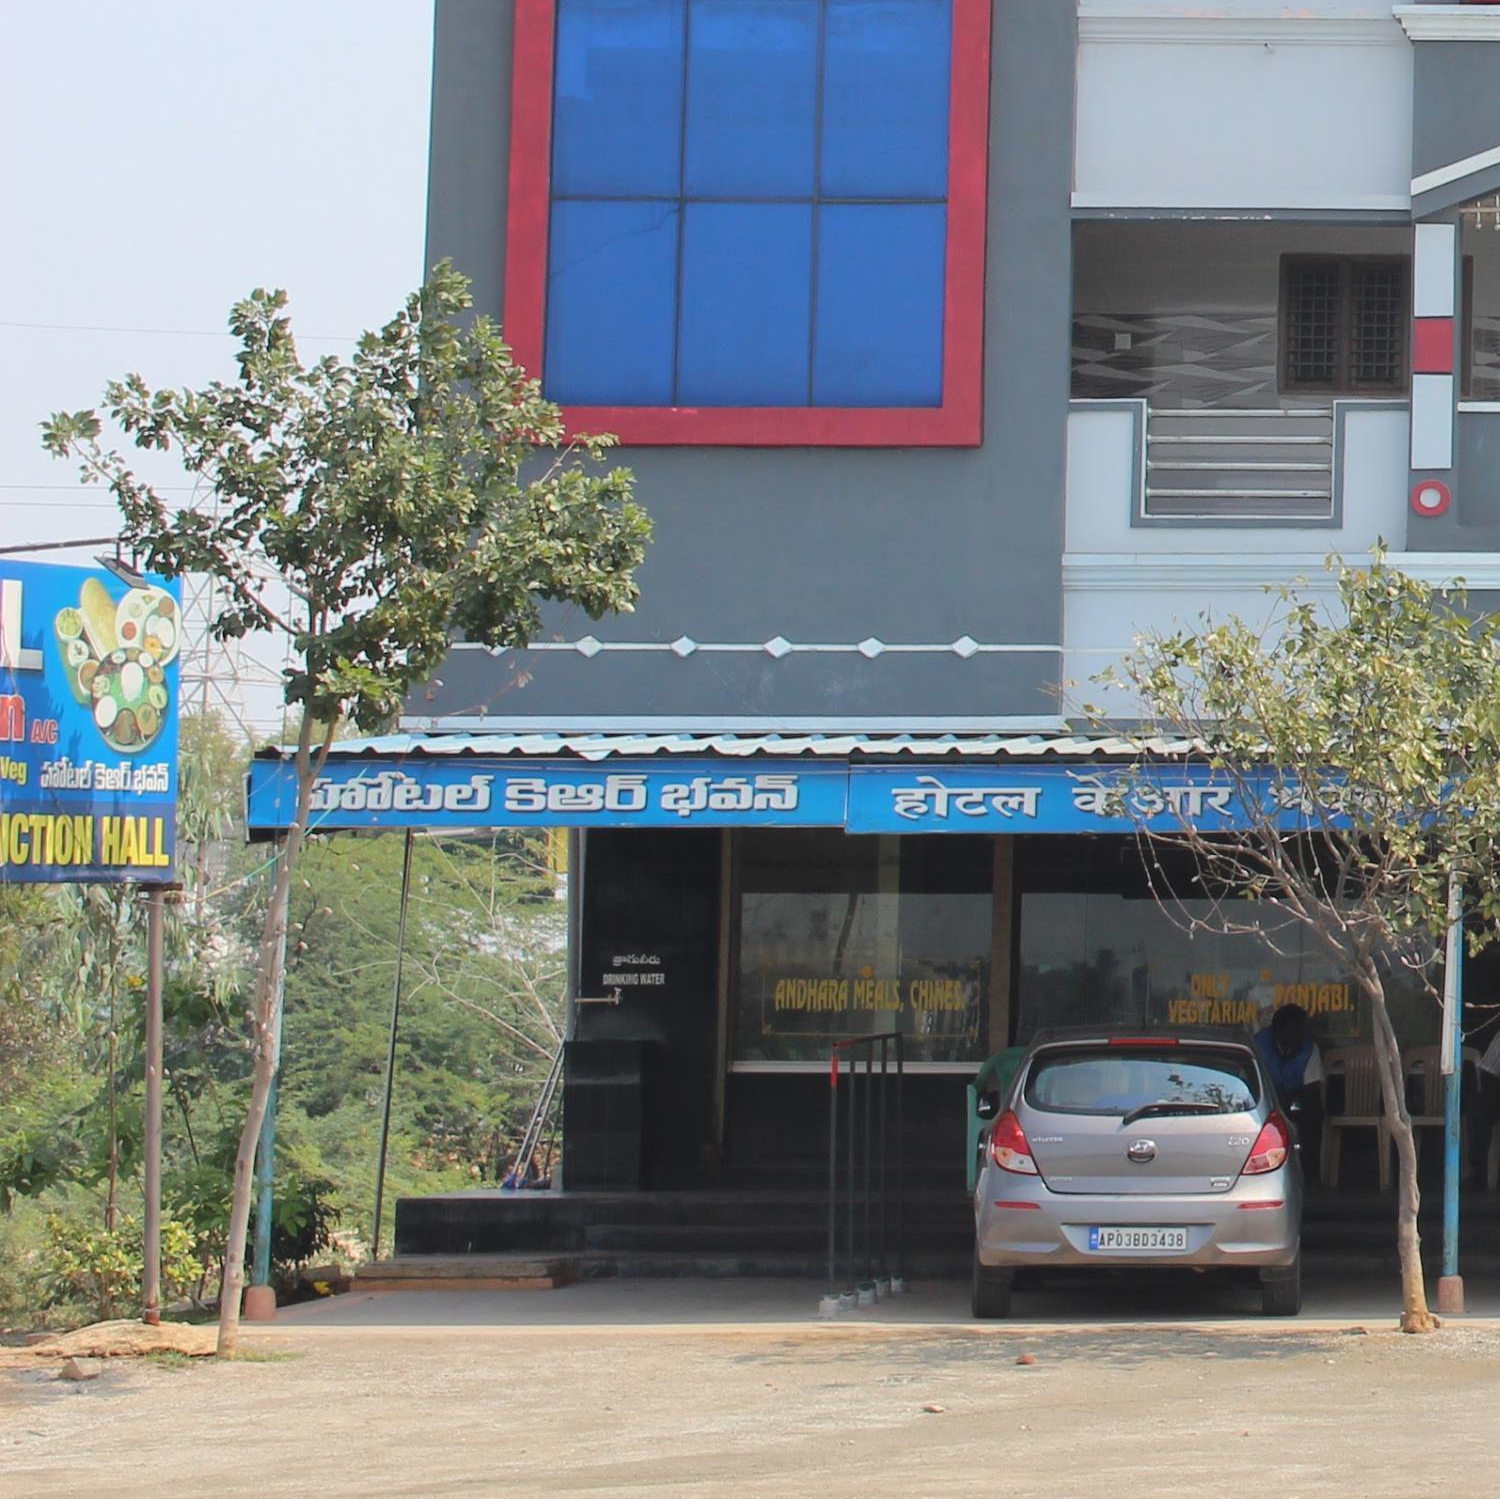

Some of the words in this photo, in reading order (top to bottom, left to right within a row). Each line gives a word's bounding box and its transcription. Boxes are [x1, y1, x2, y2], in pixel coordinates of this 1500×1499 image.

[31, 718, 58, 744] A/C
[660, 774, 799, 817] భవన్
[891, 775, 1043, 820] होटल
[102, 816, 170, 866] HALL
[602, 973, 639, 985] DRINKING
[639, 973, 666, 985] WATER
[1190, 972, 1232, 998] ONLY
[774, 978, 850, 1013] ANDHARA
[1098, 1232, 1184, 1246] AP03BD3438
